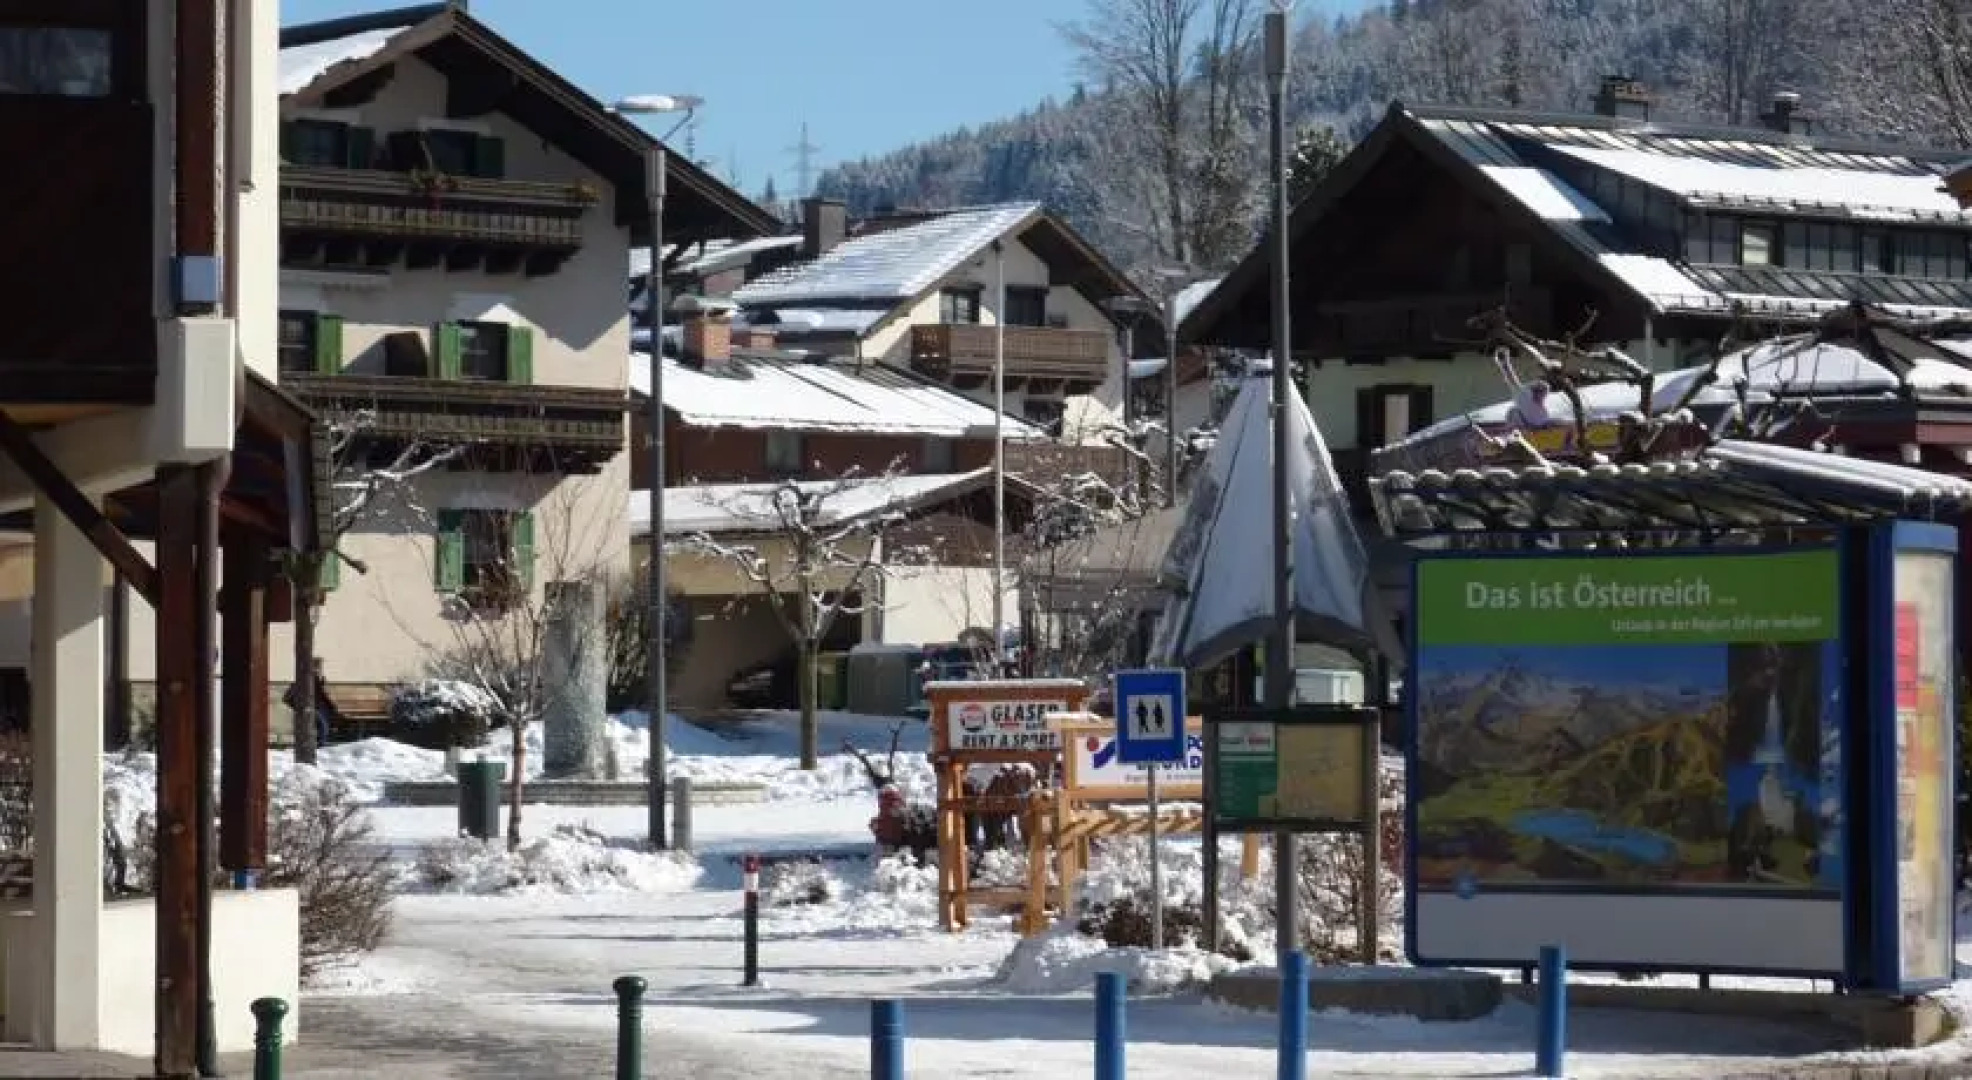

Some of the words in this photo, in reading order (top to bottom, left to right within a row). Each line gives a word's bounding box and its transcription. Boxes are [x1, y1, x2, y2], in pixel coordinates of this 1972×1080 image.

[1465, 581, 1521, 609] Das
[1529, 580, 1567, 609] ist
[1573, 572, 1711, 608] Österreich
[1671, 617, 1689, 630] der
[962, 733, 996, 748] RENT
[1000, 733, 1009, 747] A
